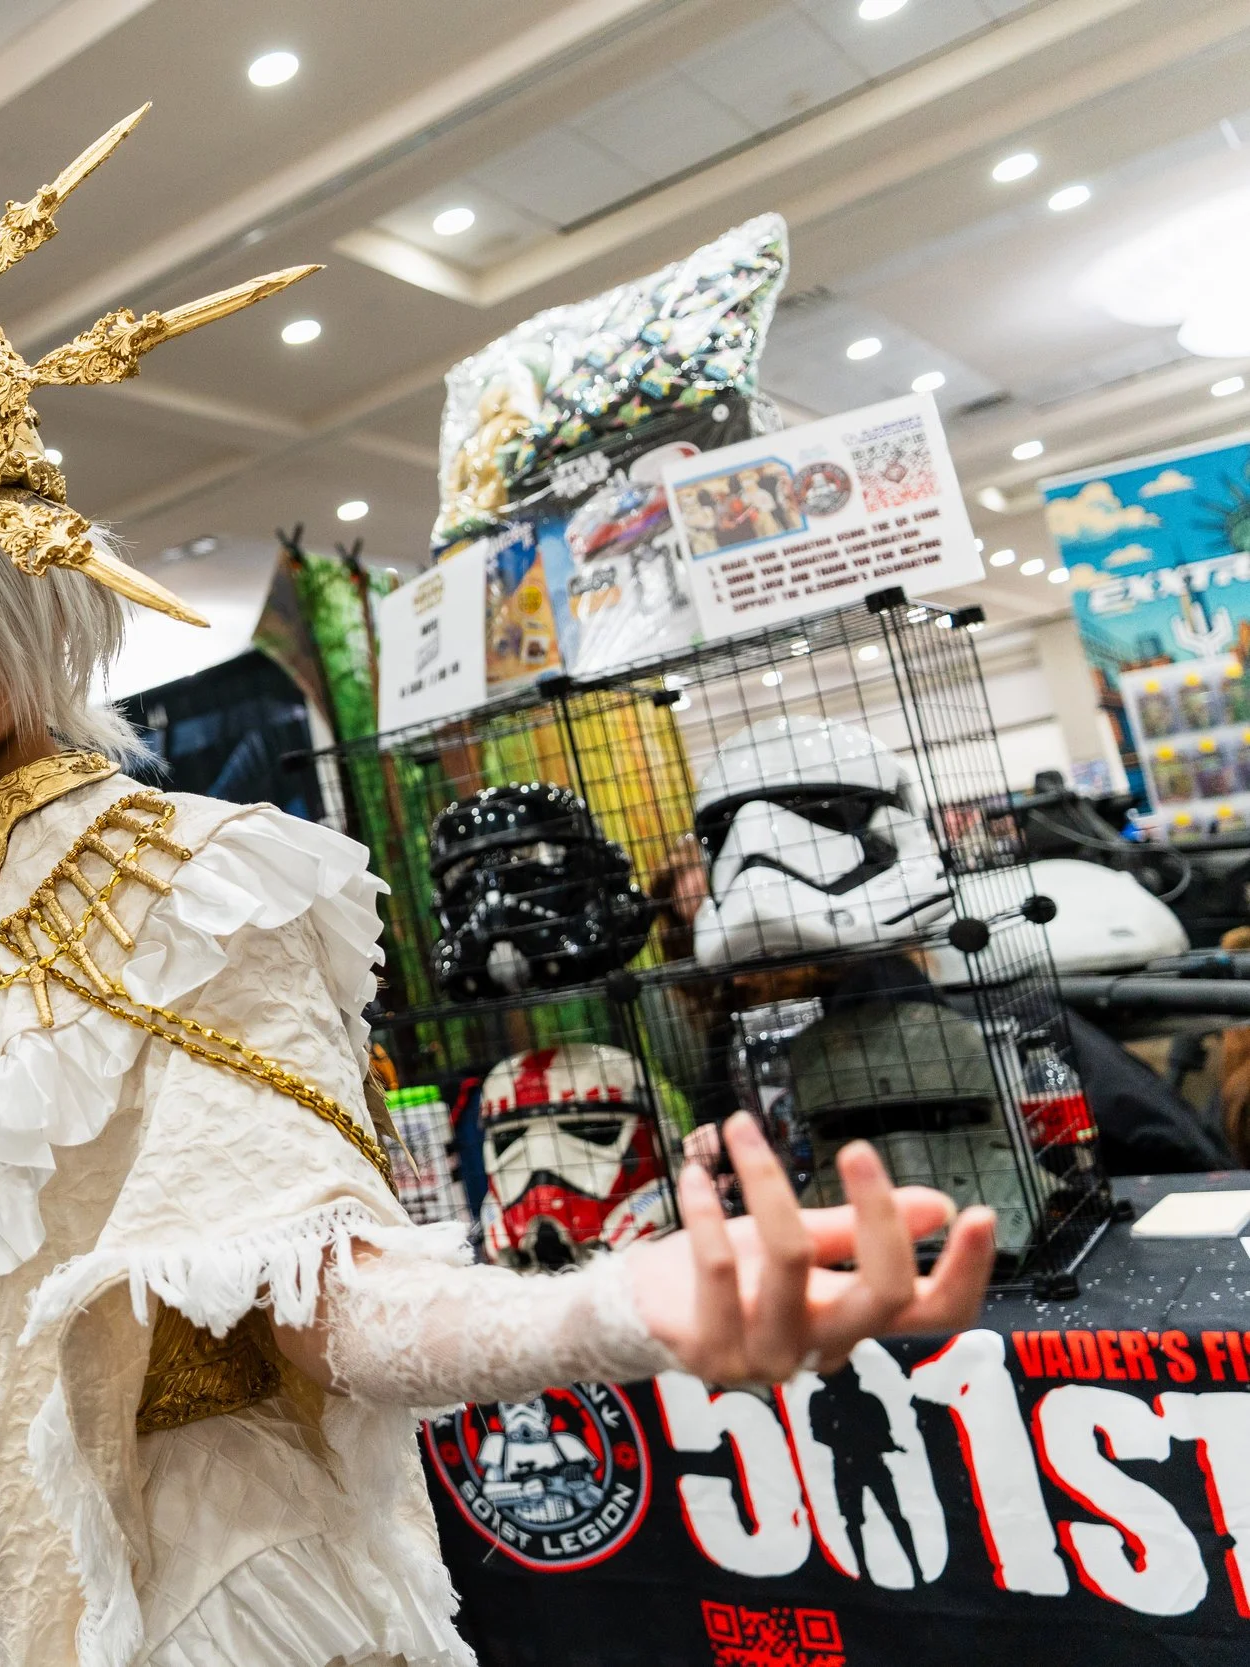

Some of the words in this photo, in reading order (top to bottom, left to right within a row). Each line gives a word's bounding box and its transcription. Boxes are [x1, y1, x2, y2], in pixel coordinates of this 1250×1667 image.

[782, 538, 832, 556] DONATION
[872, 522, 890, 533] THE
[895, 517, 908, 527] QR
[914, 509, 941, 522] CODE
[900, 538, 942, 555] HELPING
[790, 550, 840, 568] DONATION
[732, 595, 777, 612] SUPPORT
[782, 589, 799, 600] THE
[1012, 1330, 1197, 1383] VADER'S
[1201, 1330, 1250, 1383] FI
[459, 1480, 532, 1549] 501ST
[542, 1482, 634, 1556] LEGION
